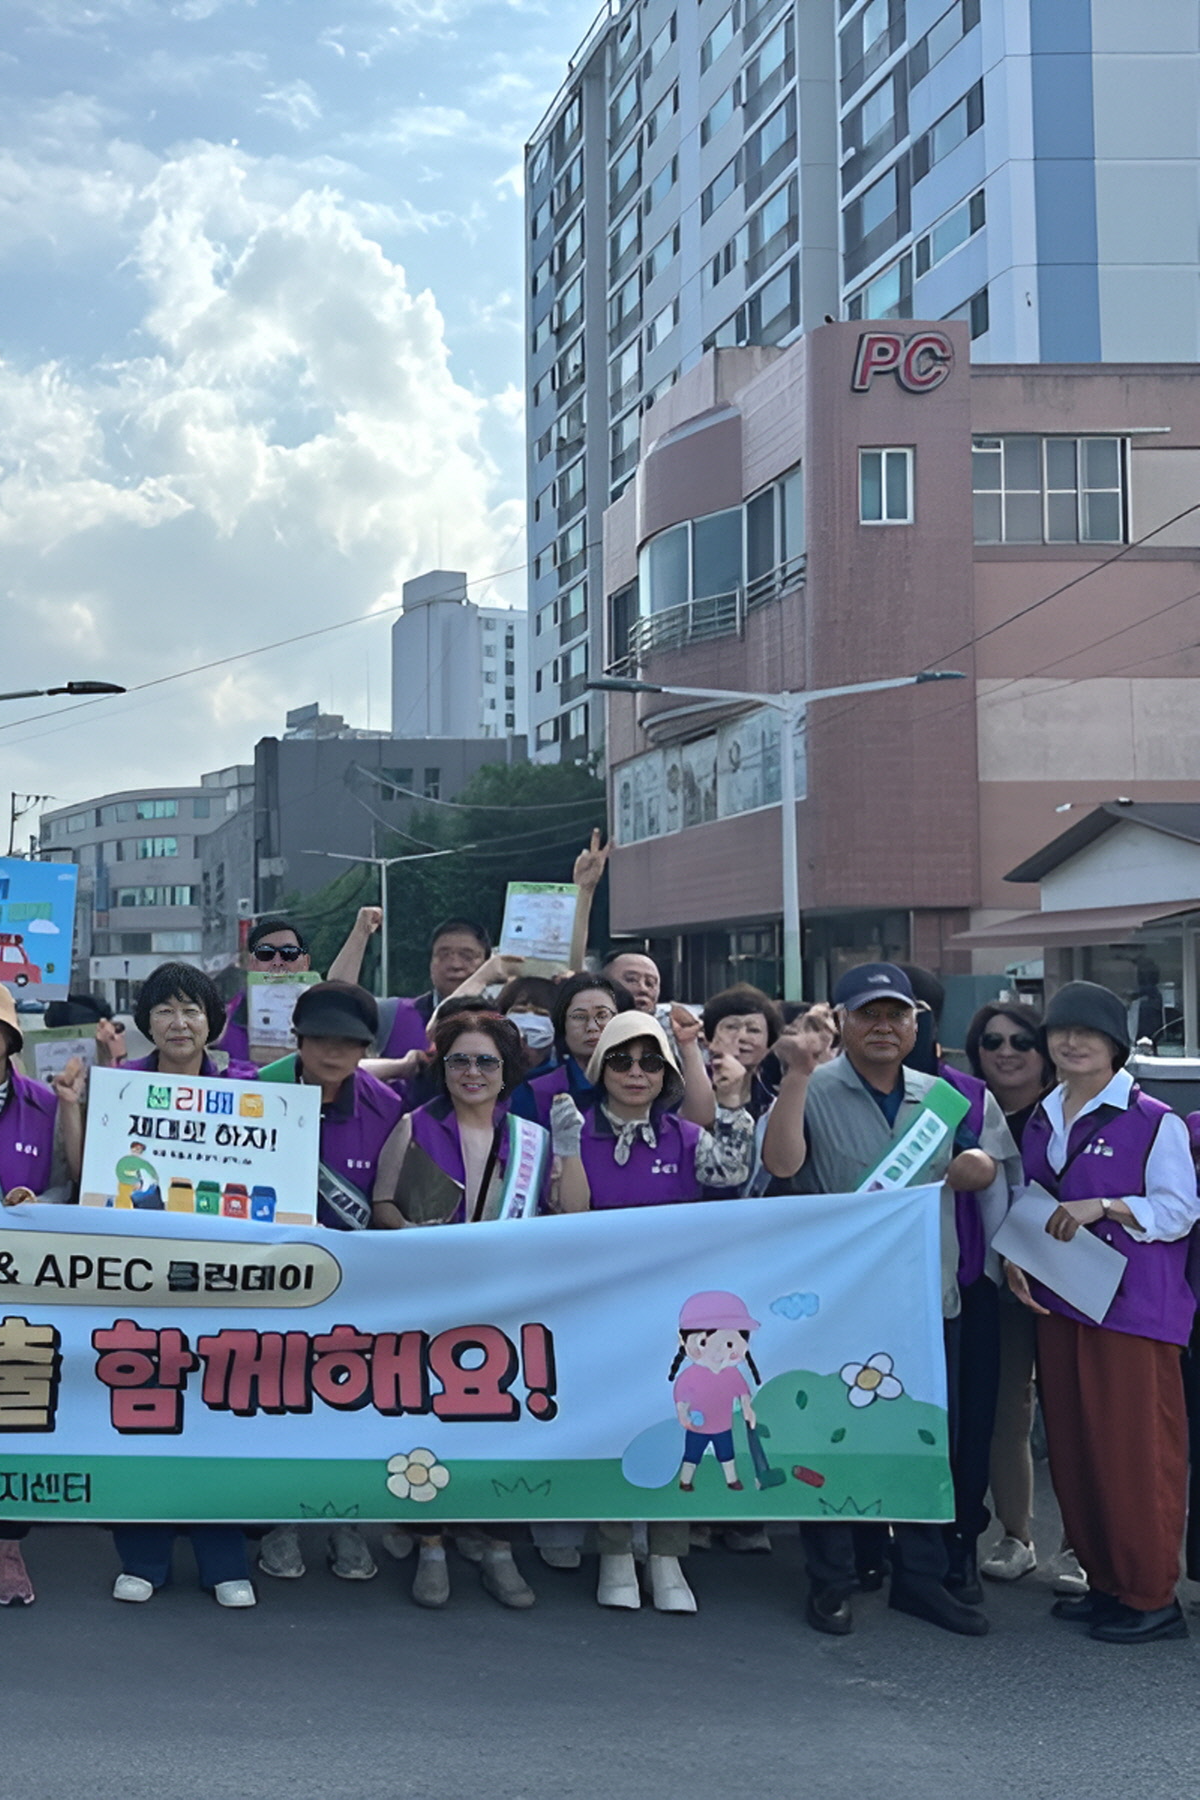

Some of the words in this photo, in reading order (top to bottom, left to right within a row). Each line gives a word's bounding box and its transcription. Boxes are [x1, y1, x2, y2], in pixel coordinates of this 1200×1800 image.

[851, 331, 955, 395] PC
[215, 1123, 277, 1152] 하자!
[34, 1254, 154, 1292] APEC
[91, 1319, 558, 1435] 함께해요!
